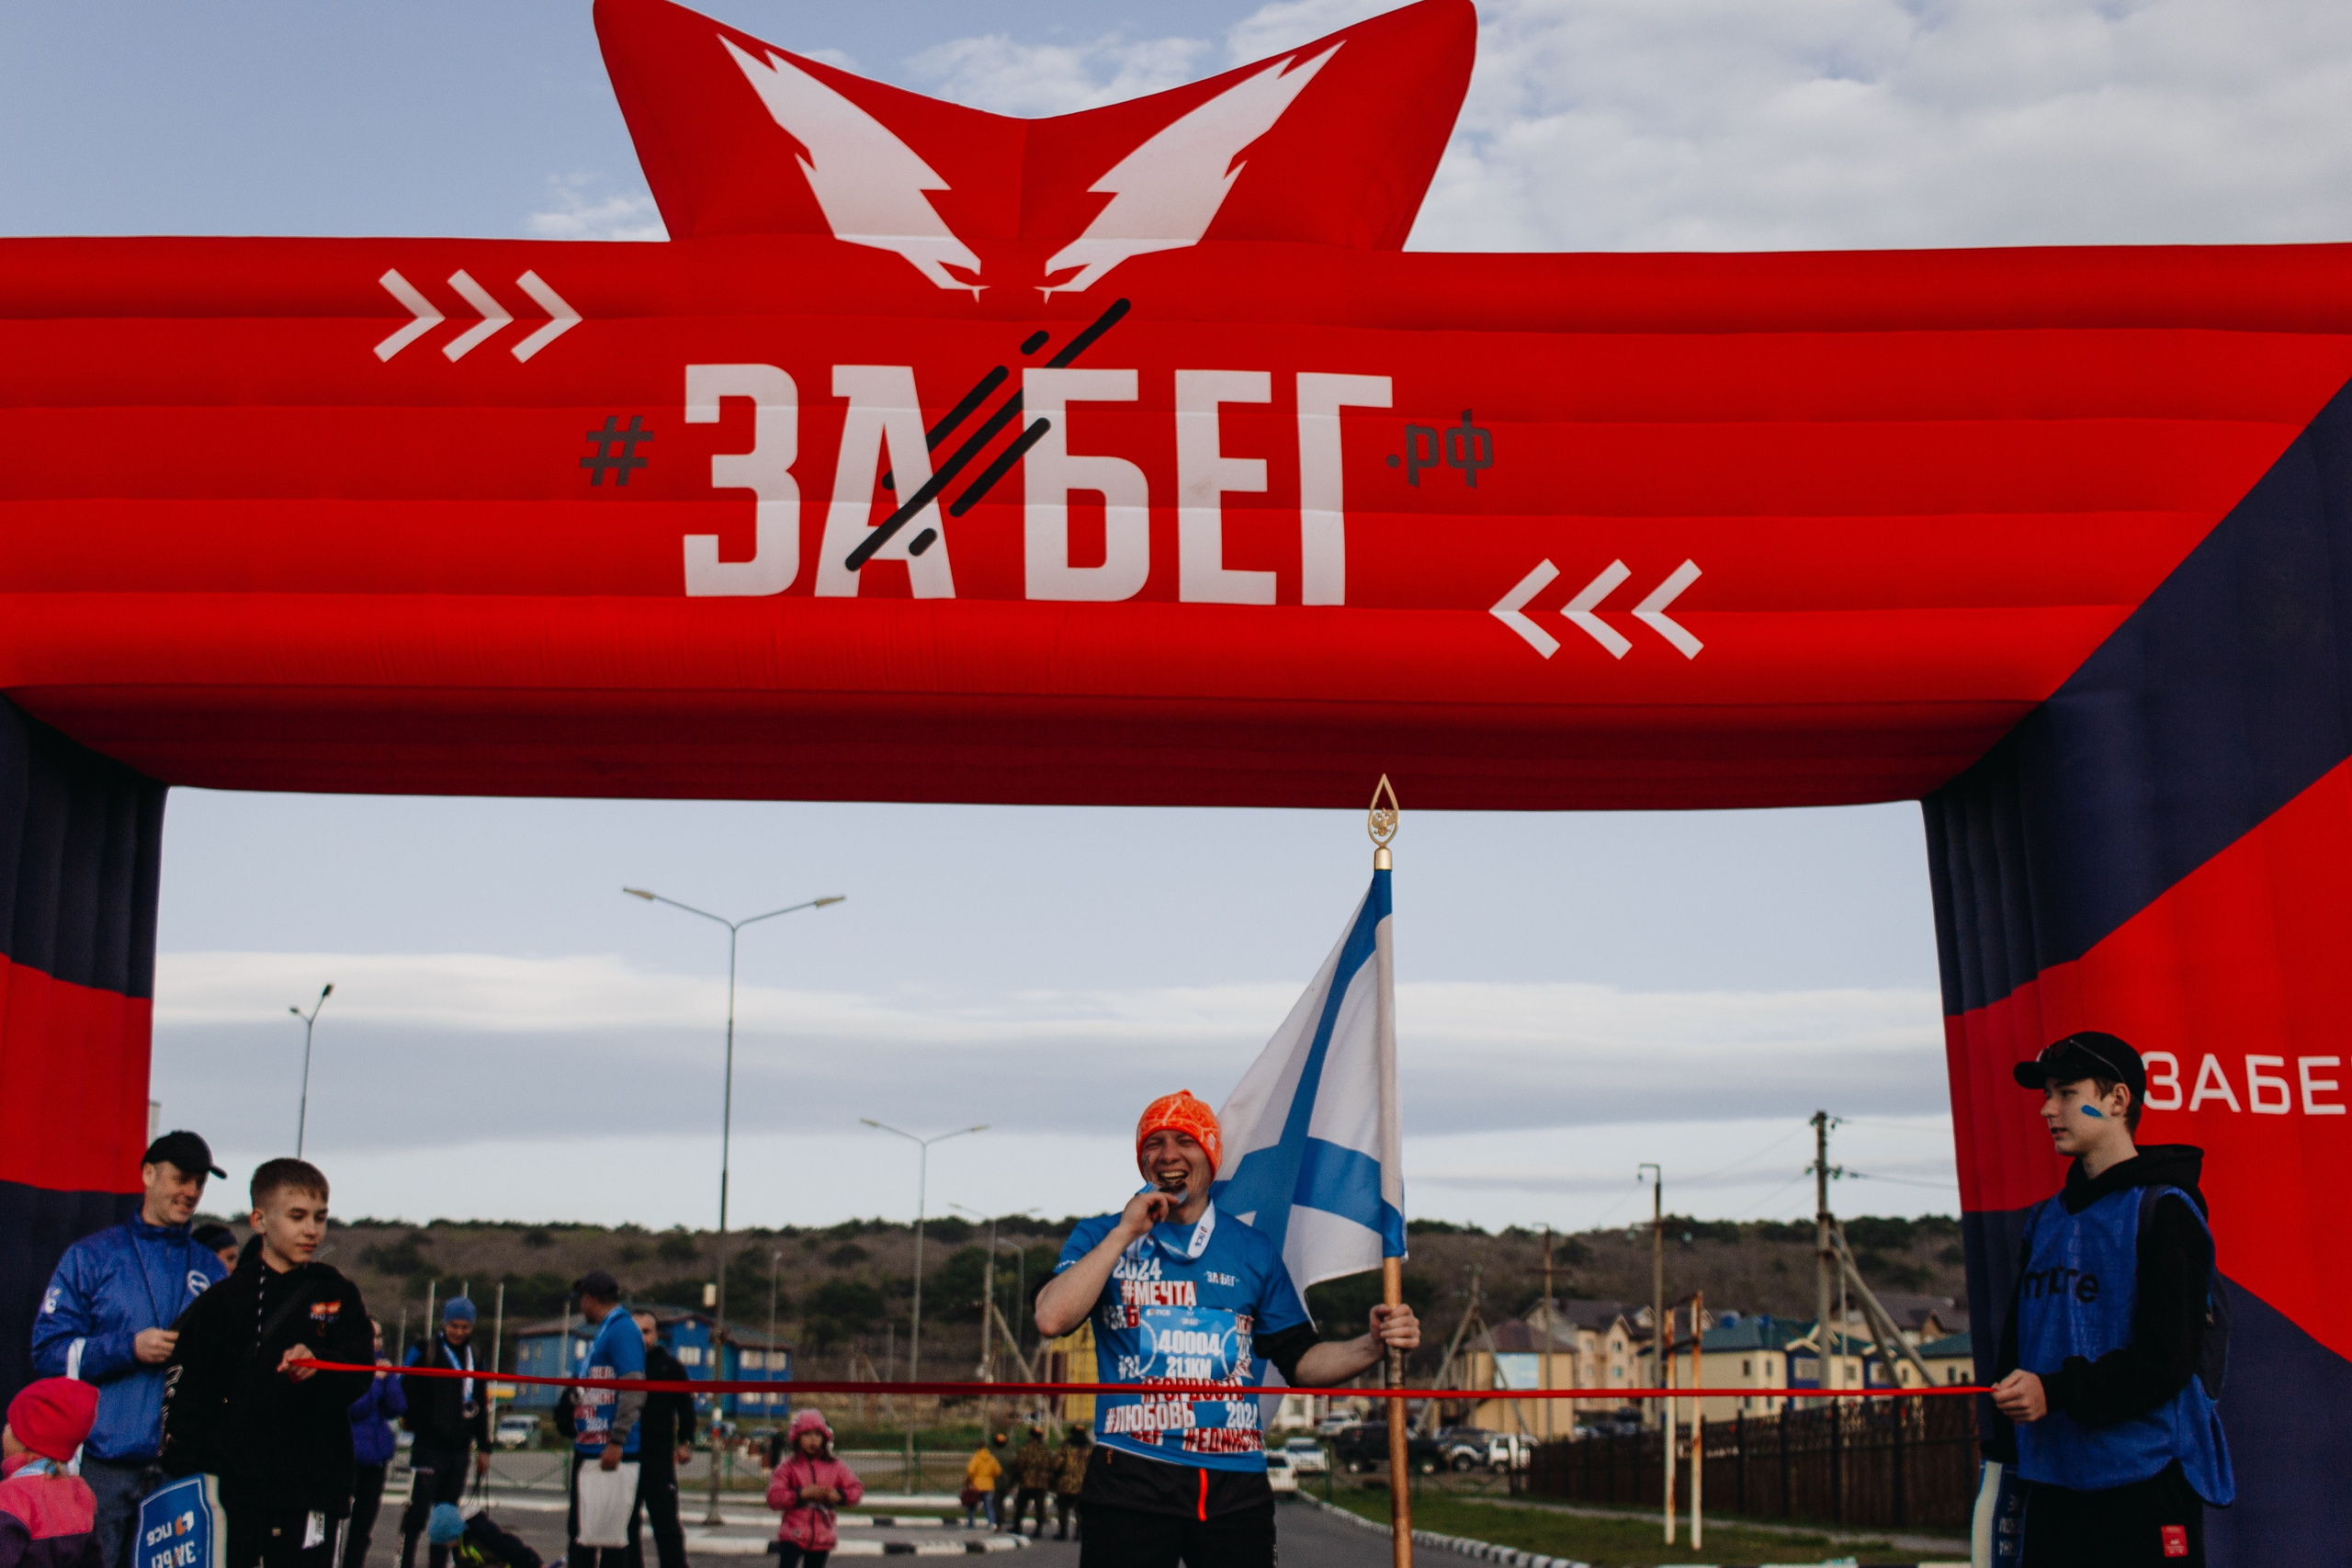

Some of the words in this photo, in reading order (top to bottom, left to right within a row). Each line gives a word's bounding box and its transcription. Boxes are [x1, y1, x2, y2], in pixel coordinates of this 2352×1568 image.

[2139, 1050, 2352, 1115] ЗАБЕ
[1113, 1257, 1162, 1281] 2024
[1121, 1280, 1197, 1306] #МЕЧТА
[1158, 1329, 1222, 1357] 40004
[1103, 1402, 1196, 1434] #ЛЮБОВЬ
